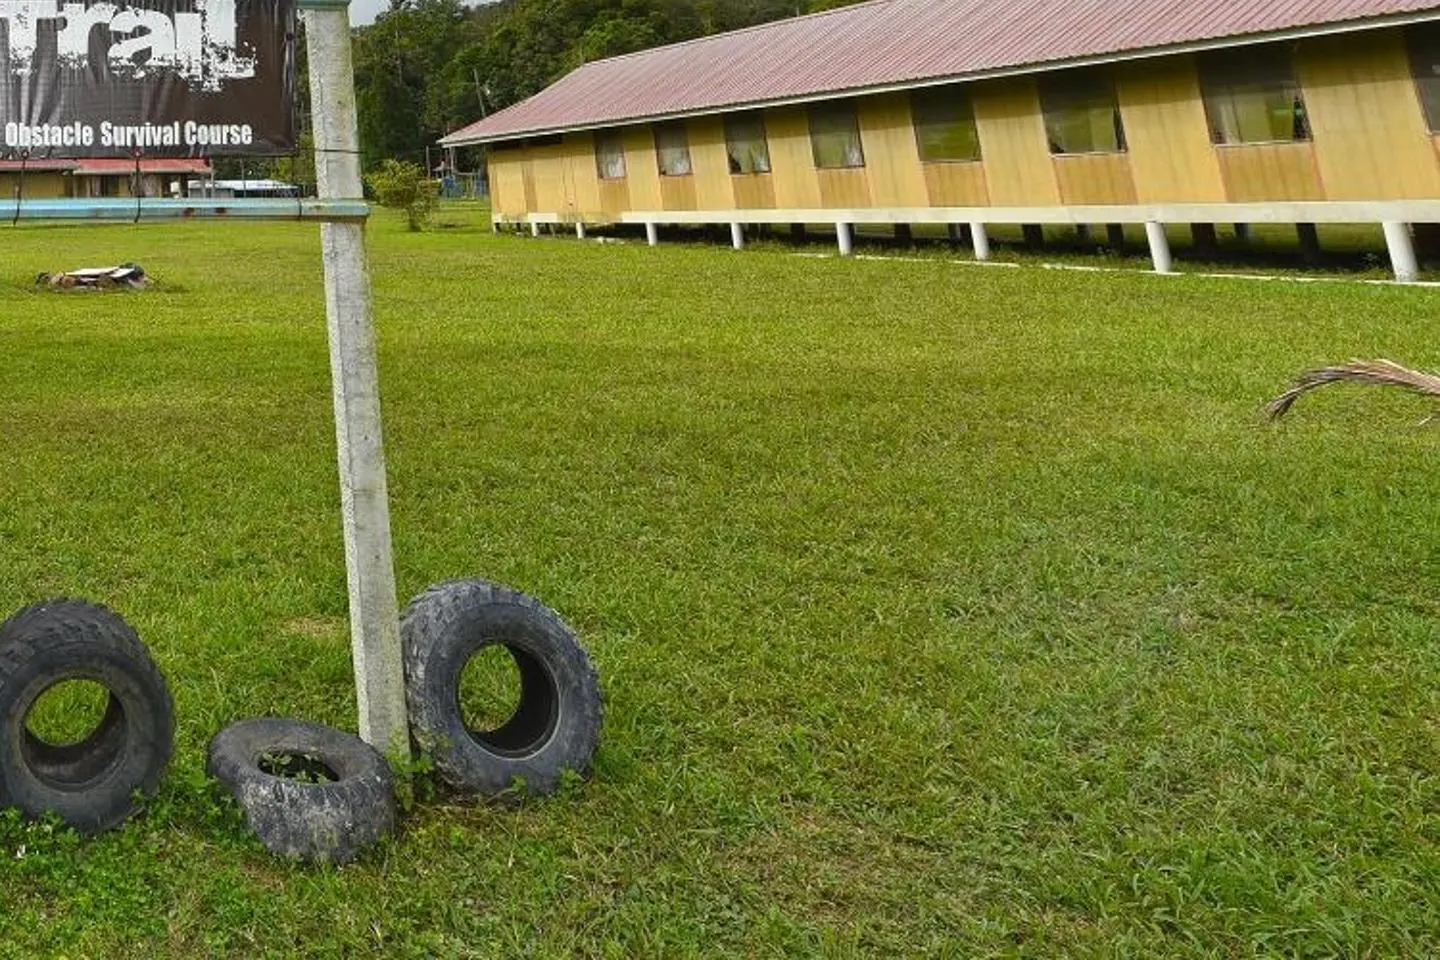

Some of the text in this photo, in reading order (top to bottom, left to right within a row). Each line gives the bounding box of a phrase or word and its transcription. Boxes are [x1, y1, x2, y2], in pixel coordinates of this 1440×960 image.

[5, 122, 93, 146] Obstacle
[101, 122, 180, 146] Survival
[185, 121, 253, 145] Course
